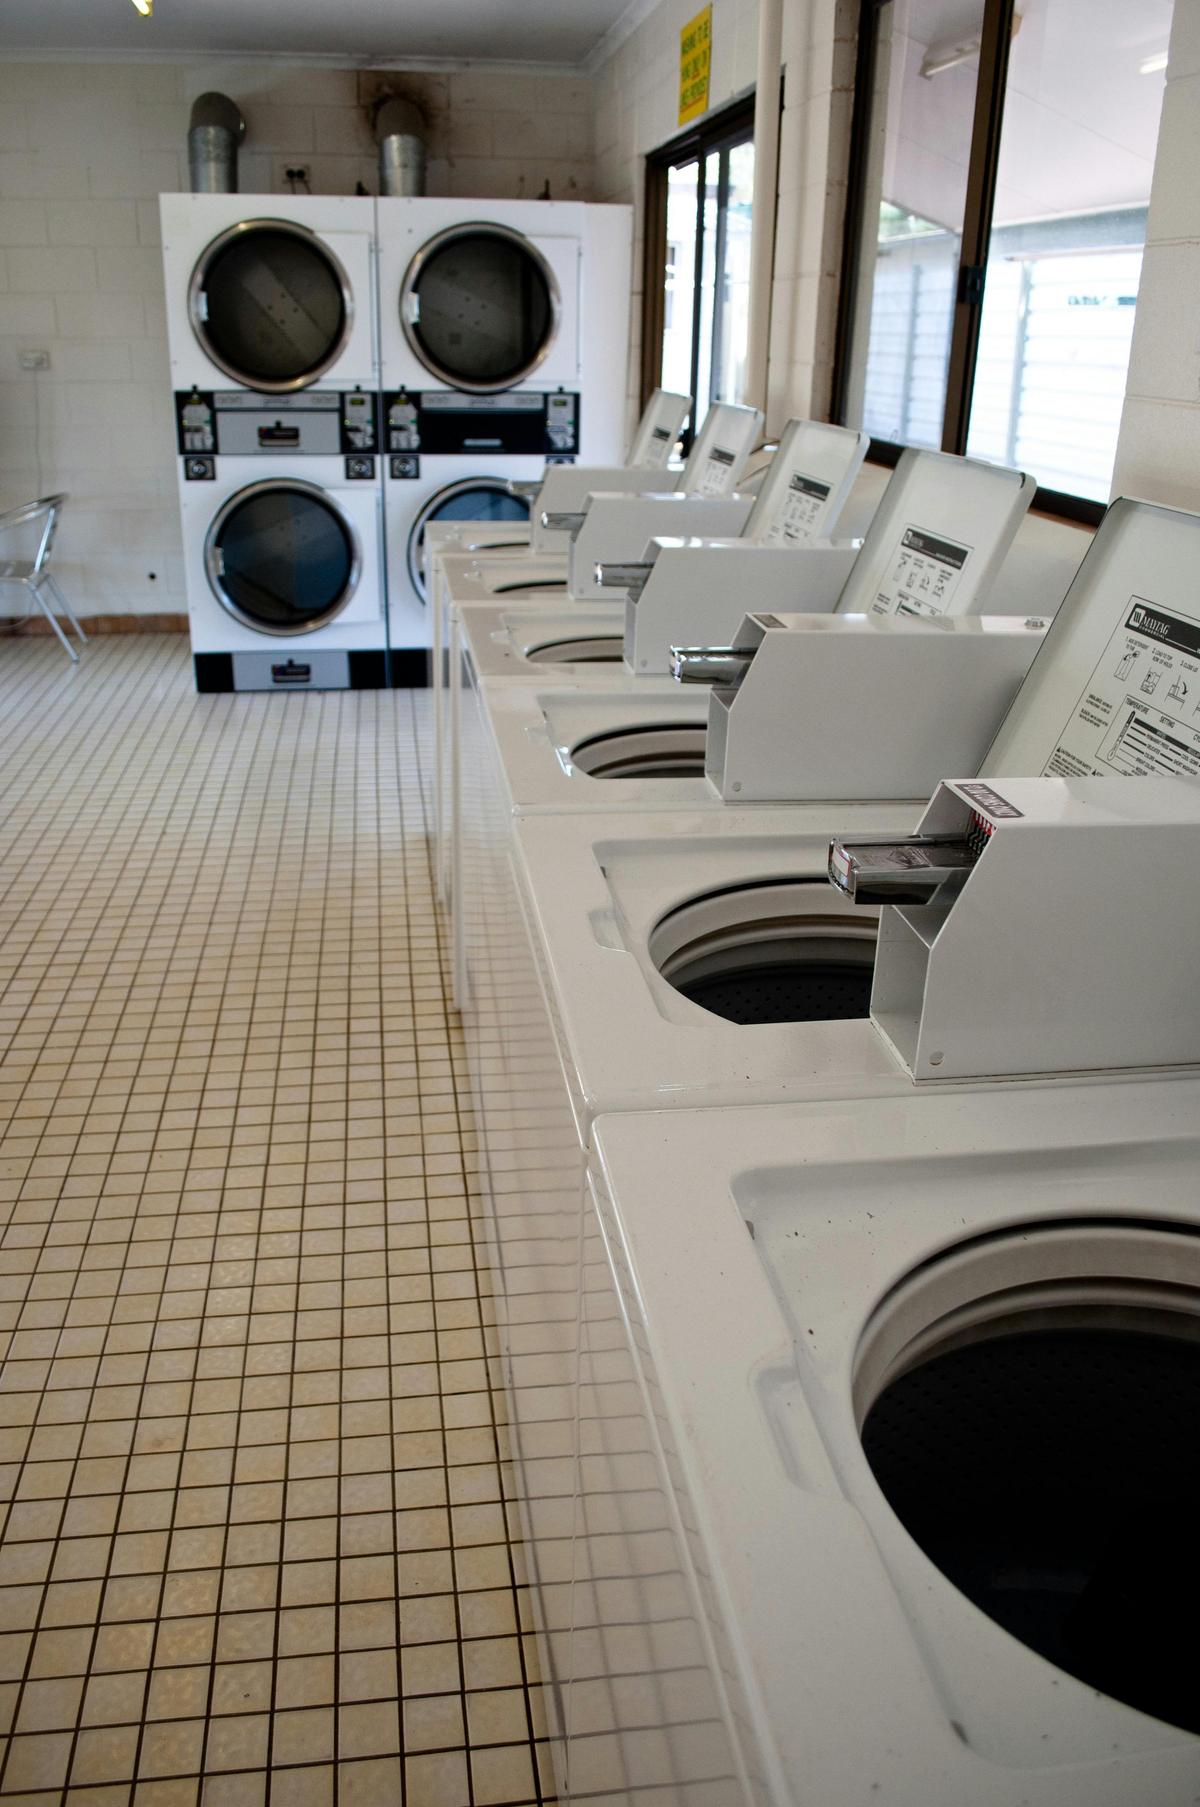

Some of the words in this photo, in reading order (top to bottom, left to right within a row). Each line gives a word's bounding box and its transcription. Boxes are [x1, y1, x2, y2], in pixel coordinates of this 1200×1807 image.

[1142, 616, 1170, 635] MAYTAG
[1125, 697, 1150, 715] TEMPERATURE
[1159, 715, 1176, 729] SETTING
